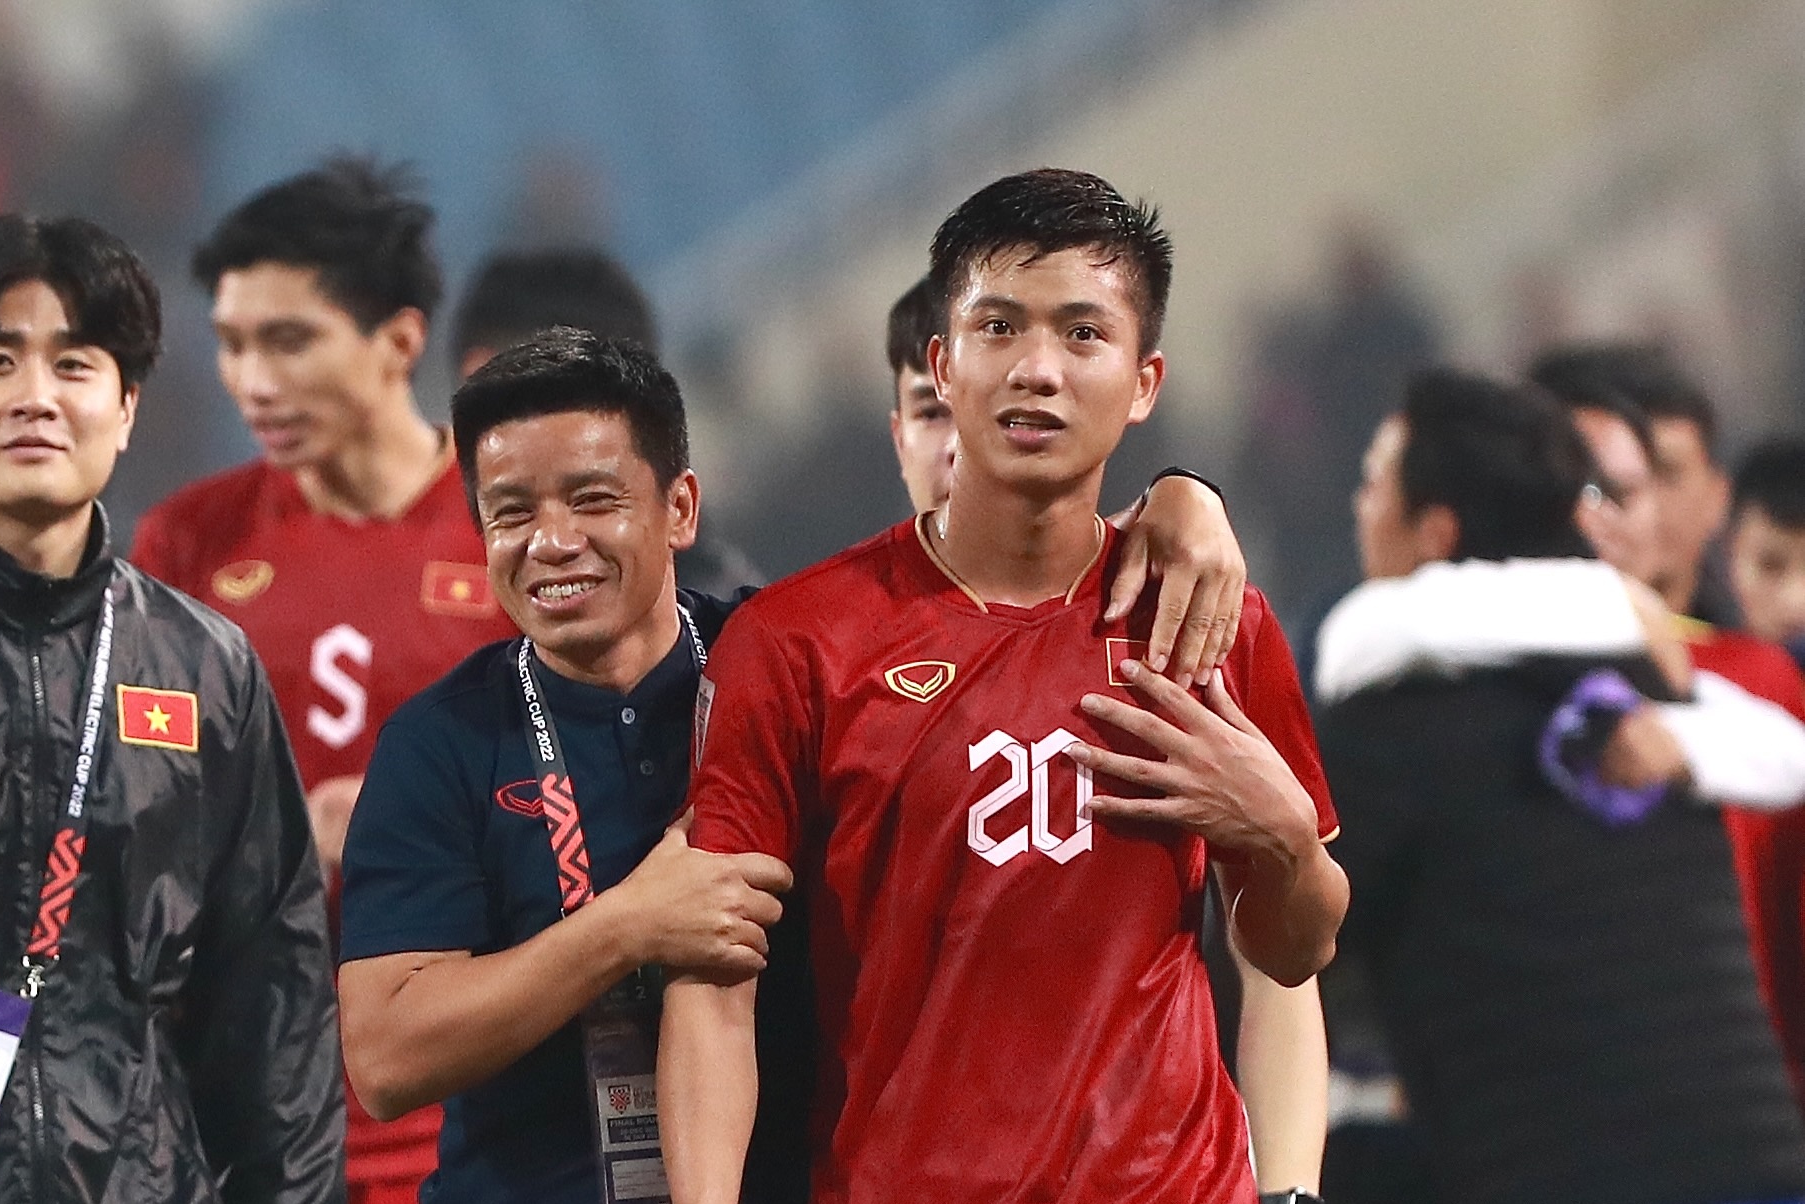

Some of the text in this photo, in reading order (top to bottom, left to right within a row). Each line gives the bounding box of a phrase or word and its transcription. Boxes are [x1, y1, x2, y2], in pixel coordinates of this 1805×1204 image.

[79, 693, 103, 755] ELECTRIC
[527, 701, 546, 730] CUP
[535, 729, 555, 762] 2022
[75, 754, 92, 784] CUP
[67, 784, 86, 818] 2022
[966, 727, 1094, 868] 20
